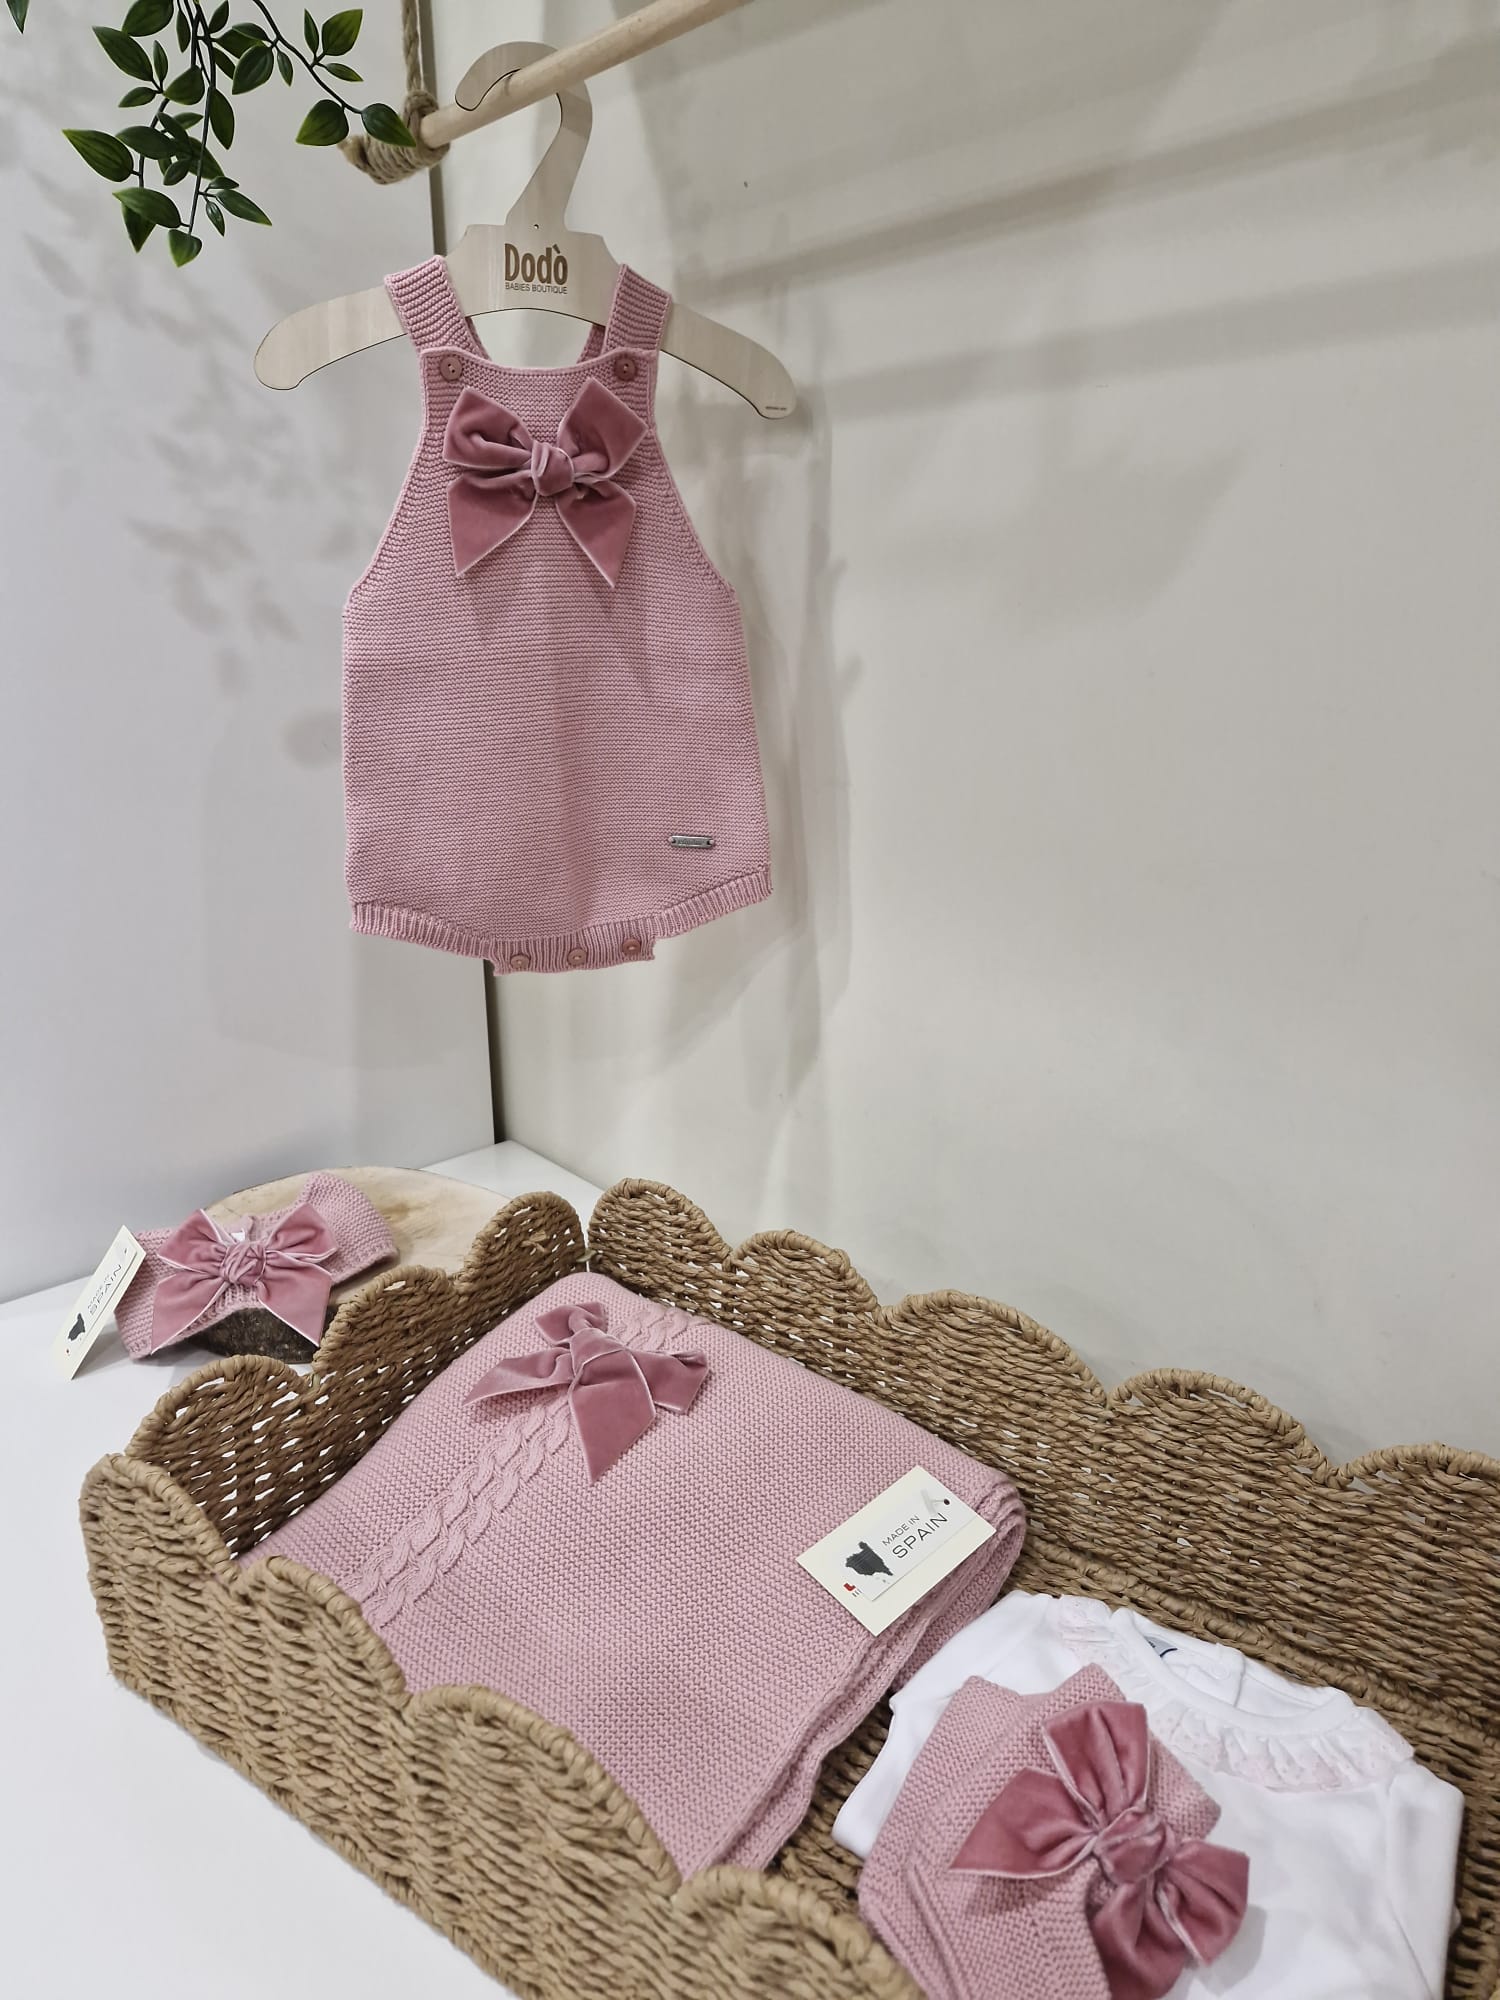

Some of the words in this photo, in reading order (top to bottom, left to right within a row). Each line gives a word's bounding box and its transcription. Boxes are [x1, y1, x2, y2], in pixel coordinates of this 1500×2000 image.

[505, 243, 568, 285] Dodò
[505, 282, 531, 292] BABIES
[531, 284, 568, 294] BOUTIQUE
[882, 1523, 909, 1546] MADE
[908, 1515, 920, 1526] IN
[892, 1512, 948, 1559] SPAIN
